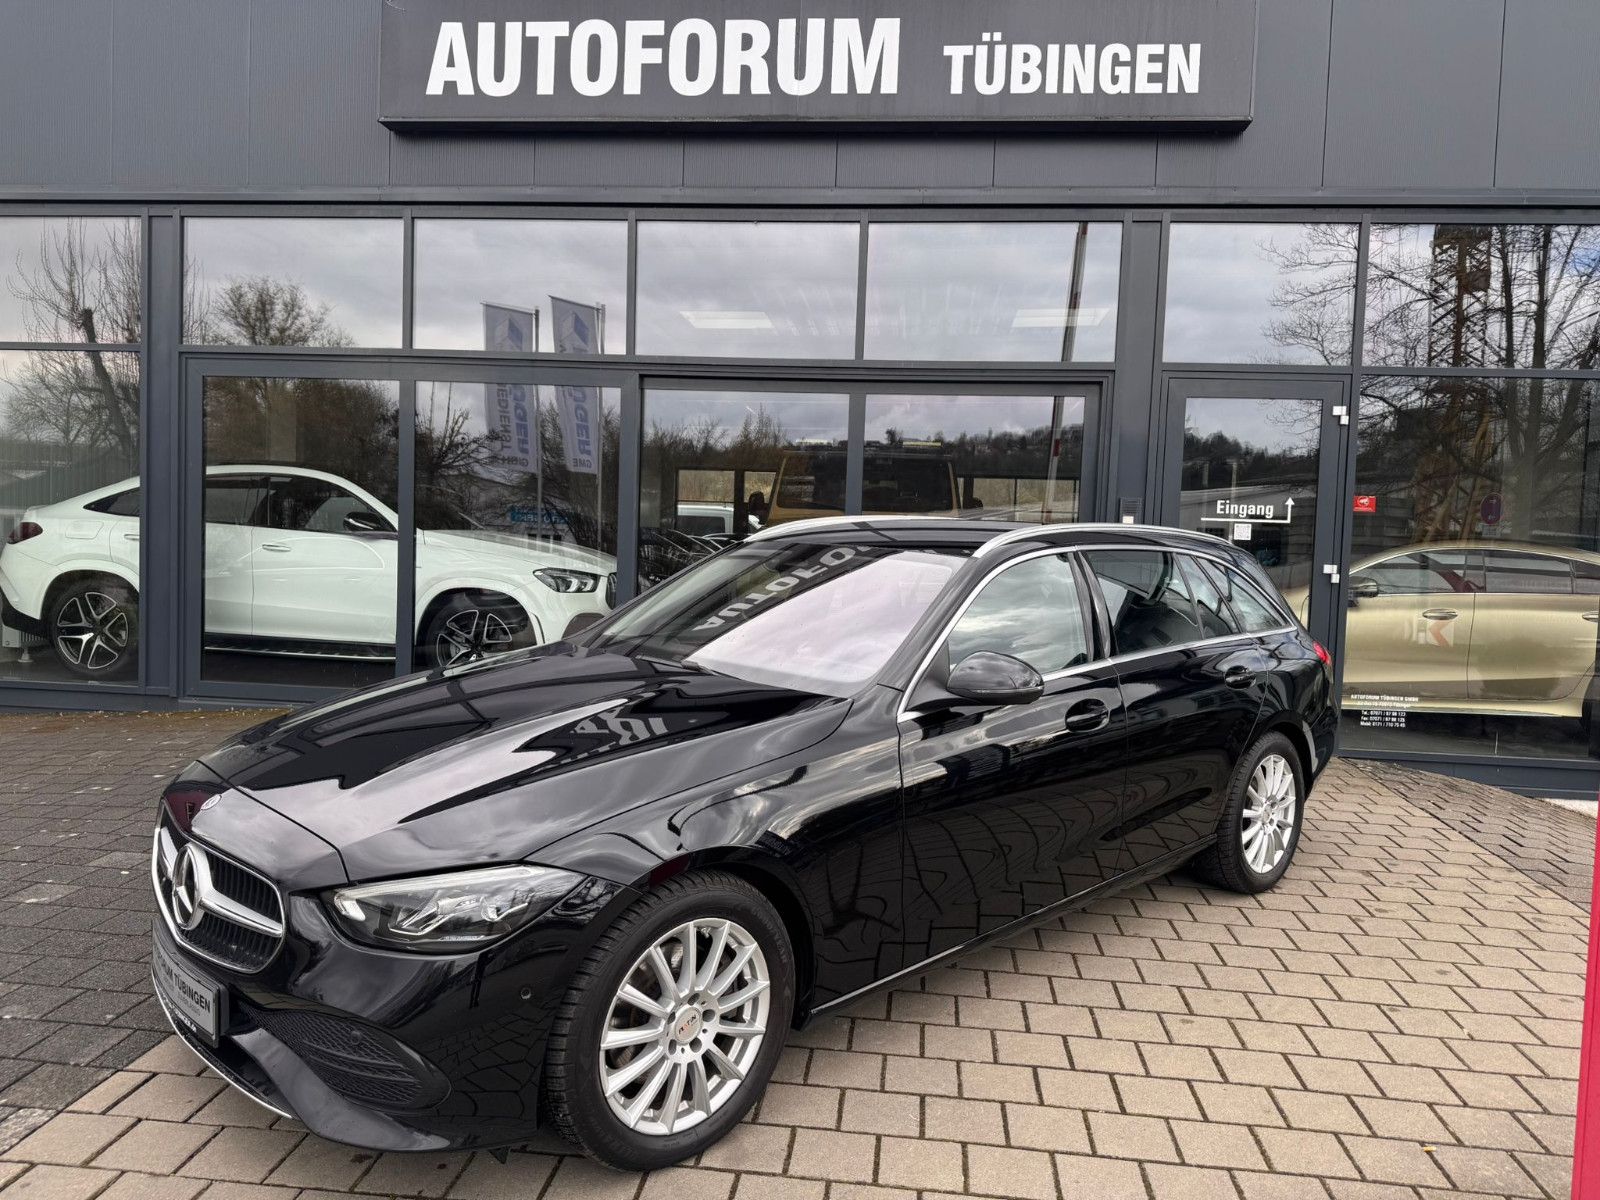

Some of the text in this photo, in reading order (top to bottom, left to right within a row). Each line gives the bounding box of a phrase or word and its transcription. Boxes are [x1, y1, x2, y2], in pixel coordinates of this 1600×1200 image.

[425, 18, 1201, 97] AUTOFORUM TÜBINGEN
[1216, 499, 1274, 519] Eingang
[173, 972, 211, 1014] TÜBINGEN
